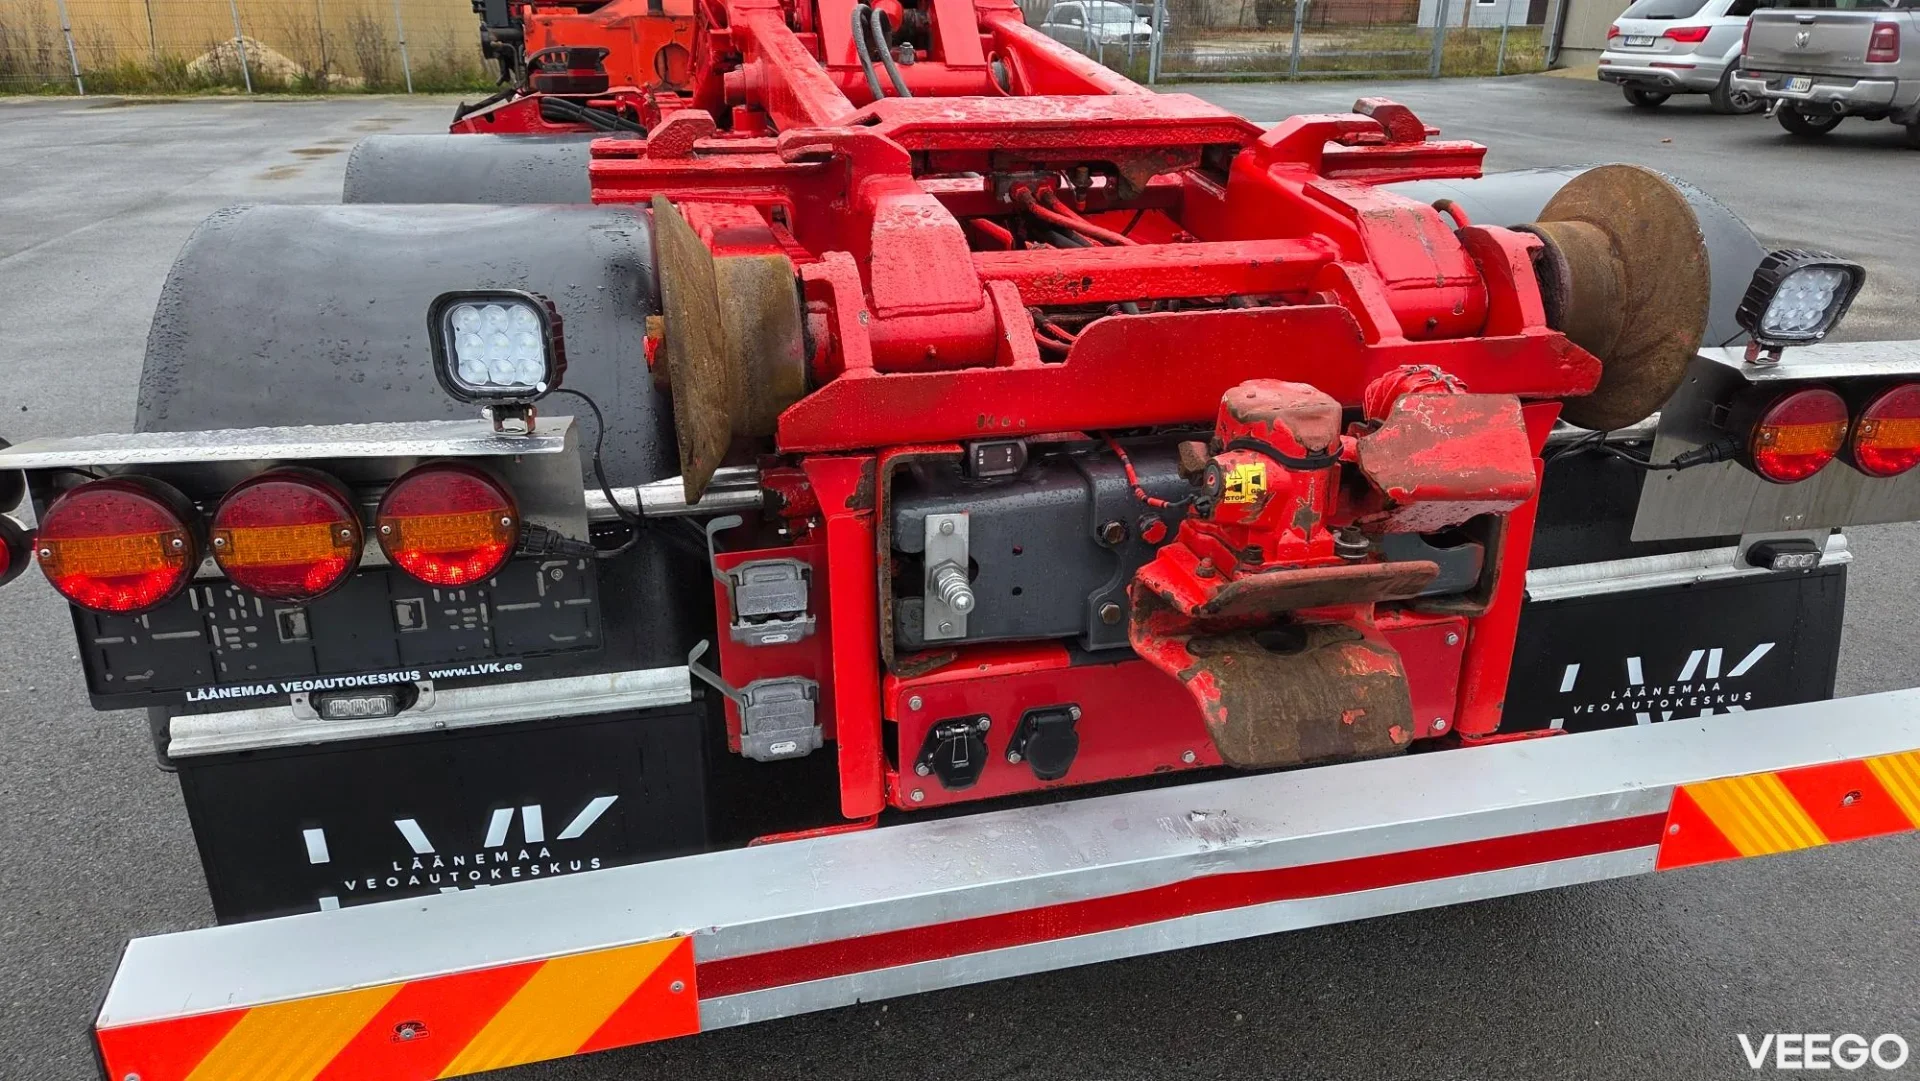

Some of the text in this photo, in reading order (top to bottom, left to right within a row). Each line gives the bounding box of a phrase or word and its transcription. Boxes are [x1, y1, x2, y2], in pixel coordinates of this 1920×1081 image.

[186, 662, 523, 702] LÄÄNEMAA VEOAUTOKESKUS www.LVK.ee
[1610, 681, 1721, 699] LÄÄNEMAA
[1572, 692, 1753, 714] VEOAUTOKESKUS
[392, 847, 551, 872] LÄÄNEMAA
[343, 857, 602, 891] VEOAUTOKESKUS
